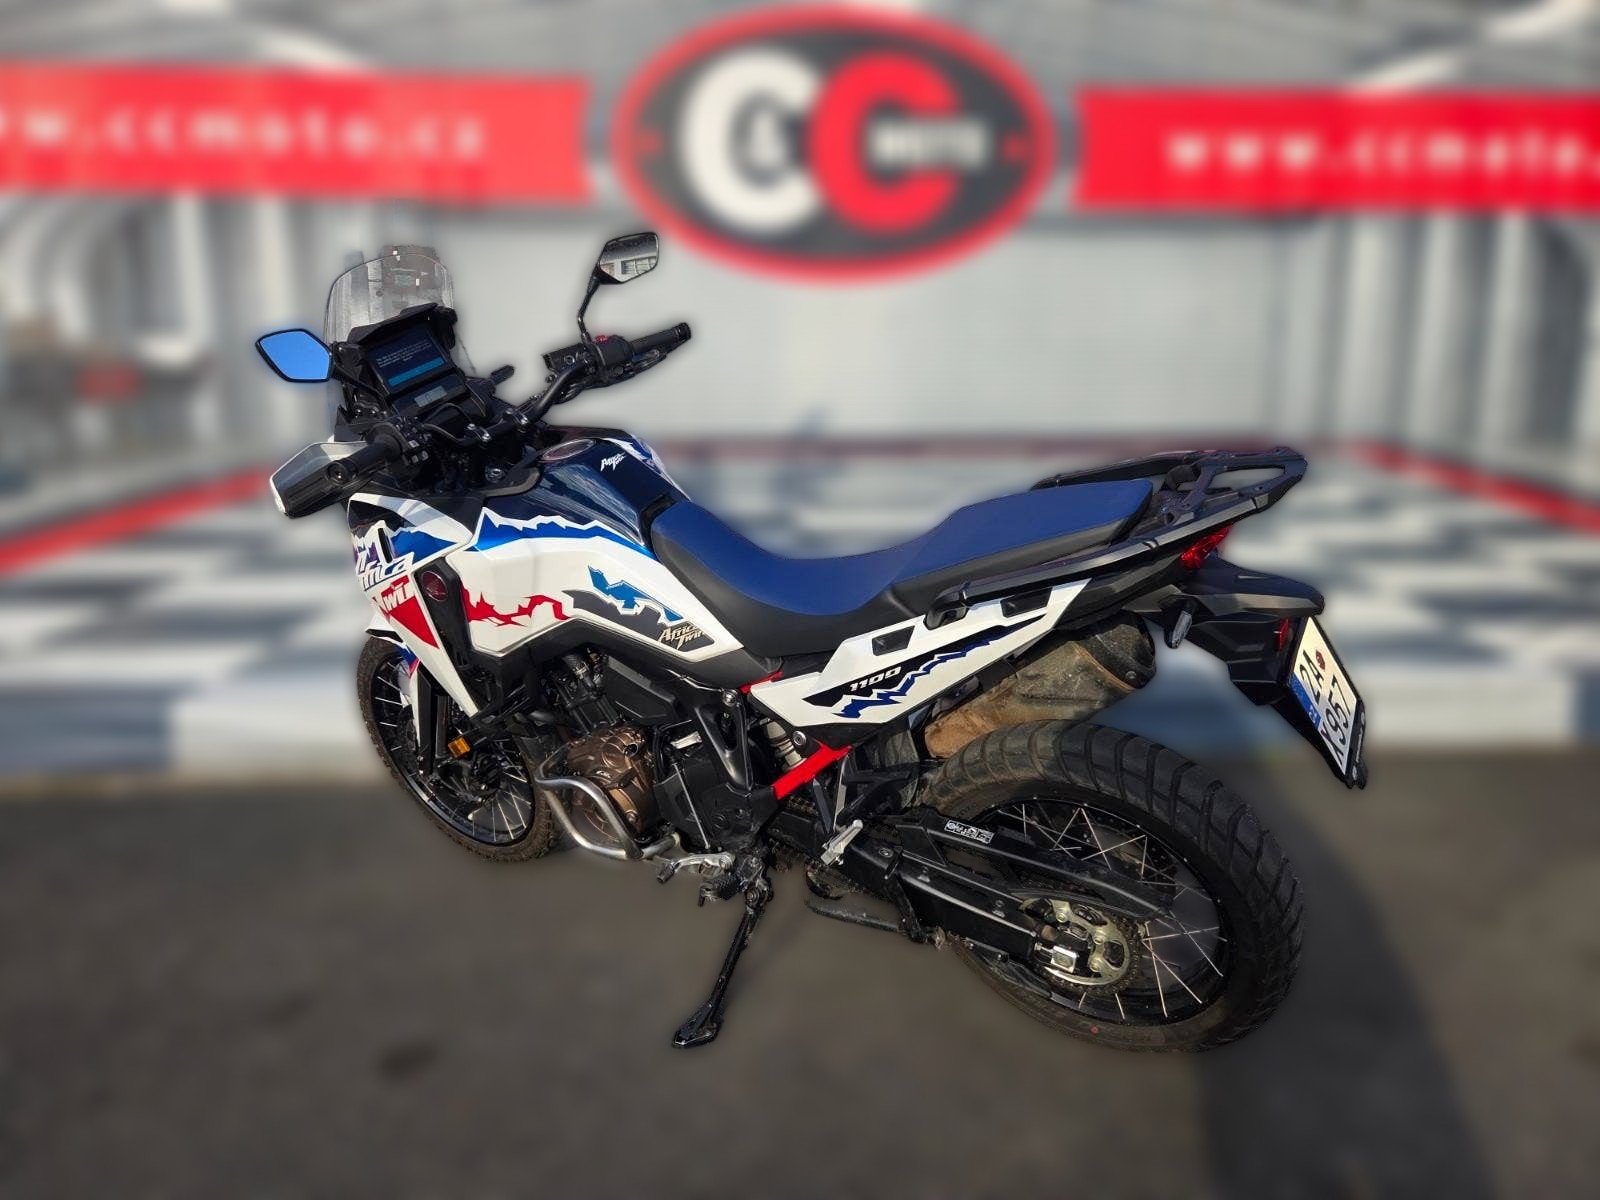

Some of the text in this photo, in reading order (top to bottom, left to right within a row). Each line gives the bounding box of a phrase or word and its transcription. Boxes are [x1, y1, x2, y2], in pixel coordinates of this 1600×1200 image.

[0, 106, 487, 162] w.ccmoto.cz
[849, 666, 902, 692] 1100
[1299, 650, 1324, 705] 2A
